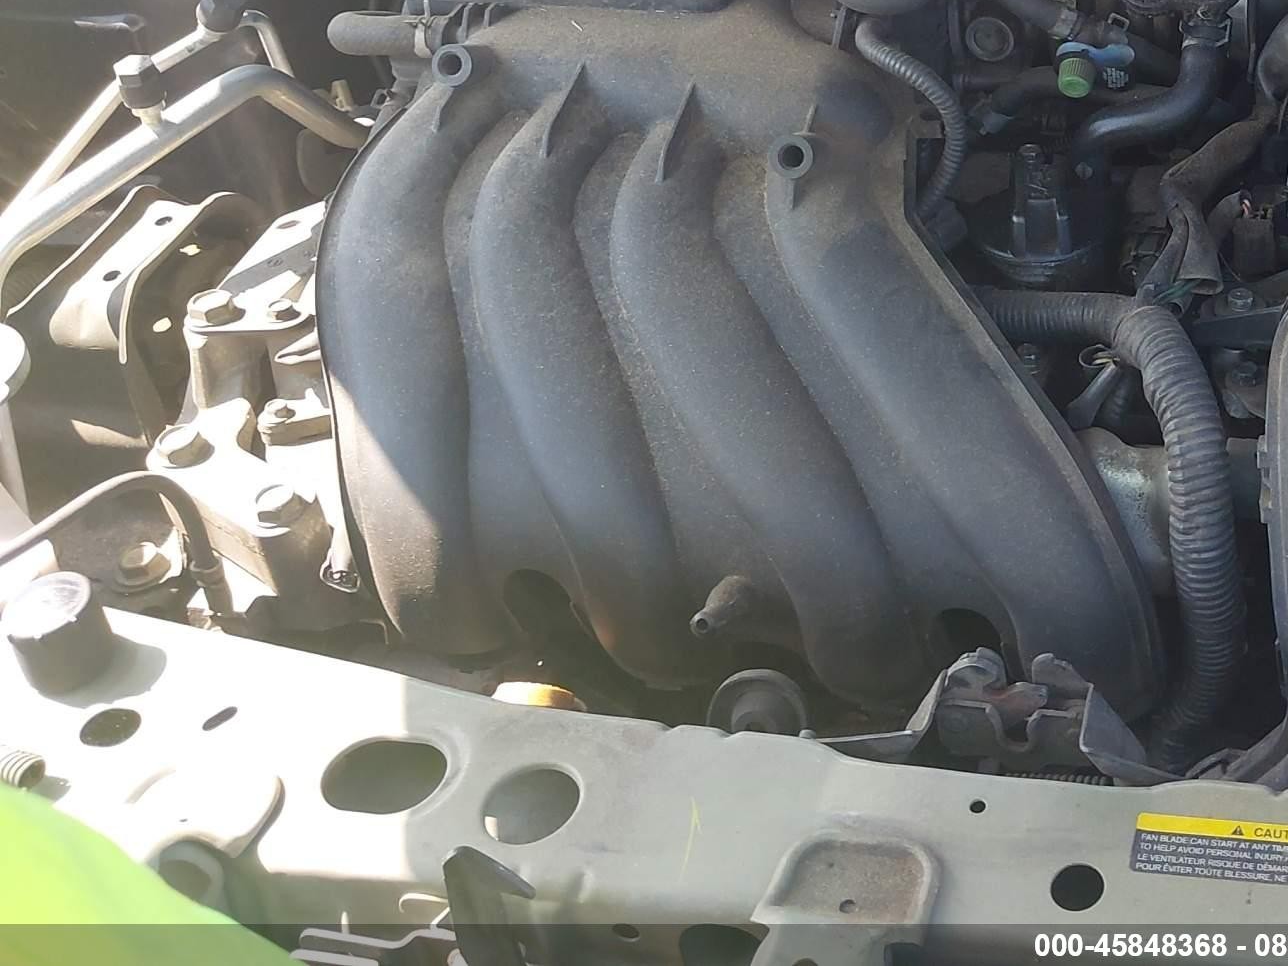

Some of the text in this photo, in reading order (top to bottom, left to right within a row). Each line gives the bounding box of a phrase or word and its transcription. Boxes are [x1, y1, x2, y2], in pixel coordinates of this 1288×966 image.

[1141, 833, 1159, 842] FAN
[1160, 834, 1188, 845] BLADE
[1190, 837, 1210, 846] CAN
[1211, 839, 1238, 849] START
[1251, 843, 1270, 851] ANY
[1140, 843, 1152, 851] TO
[1153, 844, 1177, 853] HELP
[1177, 846, 1205, 856] AVOID
[1206, 848, 1252, 860] PERSONAL
[1137, 853, 1149, 861] LE
[1150, 854, 1206, 866] VENTILATEUR
[1208, 858, 1241, 869] RISQUE
[1243, 861, 1255, 869] DE
[1136, 862, 1161, 872] POUR
[1163, 863, 1192, 874] ÉVITER
[1194, 867, 1223, 877] TOUTE
[1274, 874, 1287, 882] NE
